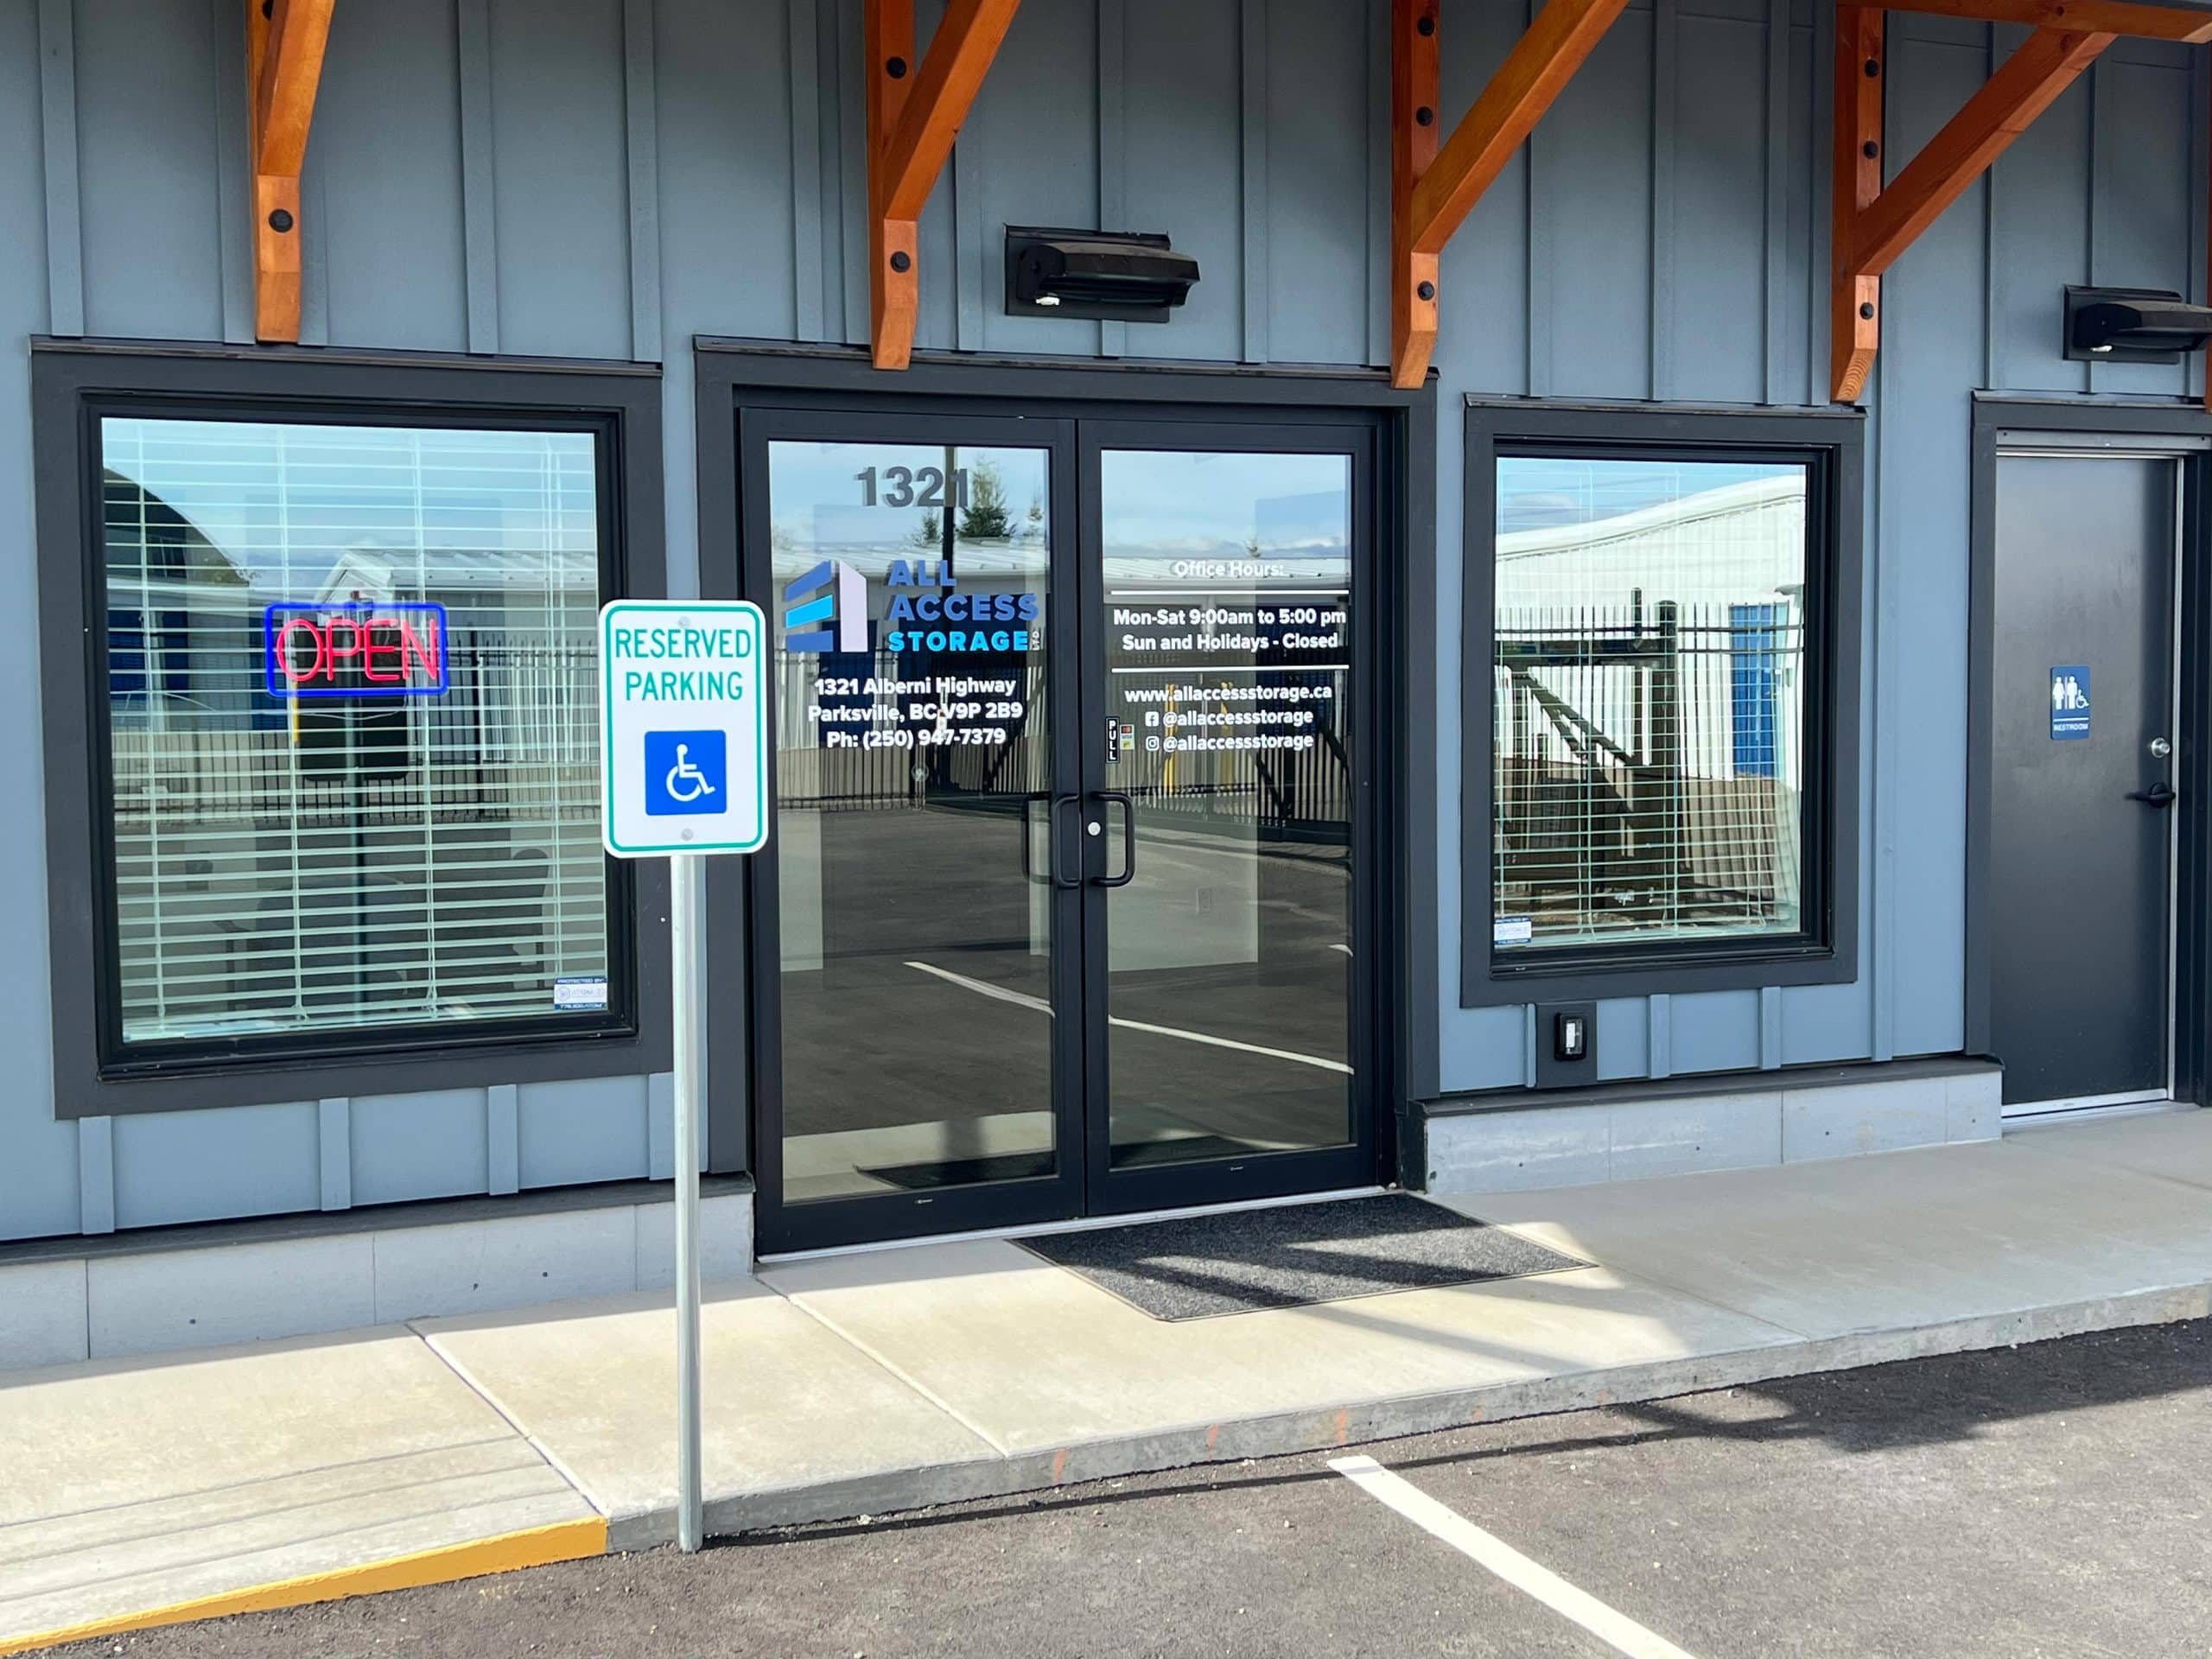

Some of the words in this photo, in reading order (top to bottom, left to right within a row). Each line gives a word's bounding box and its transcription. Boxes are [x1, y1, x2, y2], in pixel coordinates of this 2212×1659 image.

[855, 466, 969, 508] 1321
[888, 560, 957, 587] ALL
[1174, 562, 1226, 577] Office
[1230, 562, 1284, 577] Hours:
[888, 594, 1039, 621] ACCESS
[1114, 609, 1185, 625] Mon-Sat
[1189, 609, 1254, 625] 9:00am
[1257, 610, 1274, 624] to
[1279, 608, 1316, 624] 5:00
[1320, 612, 1347, 626] pm
[276, 619, 438, 681] OPEN
[615, 628, 752, 658] RESERVED
[888, 631, 1028, 652] STORAGE
[1122, 635, 1156, 650] Sun
[1160, 634, 1192, 650] and
[1197, 634, 1269, 652] Holidays
[1282, 632, 1338, 648] Closed
[625, 671, 743, 701] PARKING
[815, 678, 859, 696] 1321
[863, 677, 931, 695] Alberni
[936, 677, 1017, 696] Highway
[1124, 685, 1332, 703] www.allaccessstorage.ca
[808, 704, 906, 722] Parksville,
[909, 703, 938, 720] BC
[941, 702, 982, 719] V9P
[985, 702, 1023, 719] 2B9
[1163, 709, 1313, 727] @allaccessstorage
[826, 731, 859, 748] Ph:
[862, 730, 914, 751] (250)
[918, 728, 1007, 747] 947-7379
[1109, 720, 1117, 760] PULL
[1163, 734, 1313, 753] @allaccessstorage
